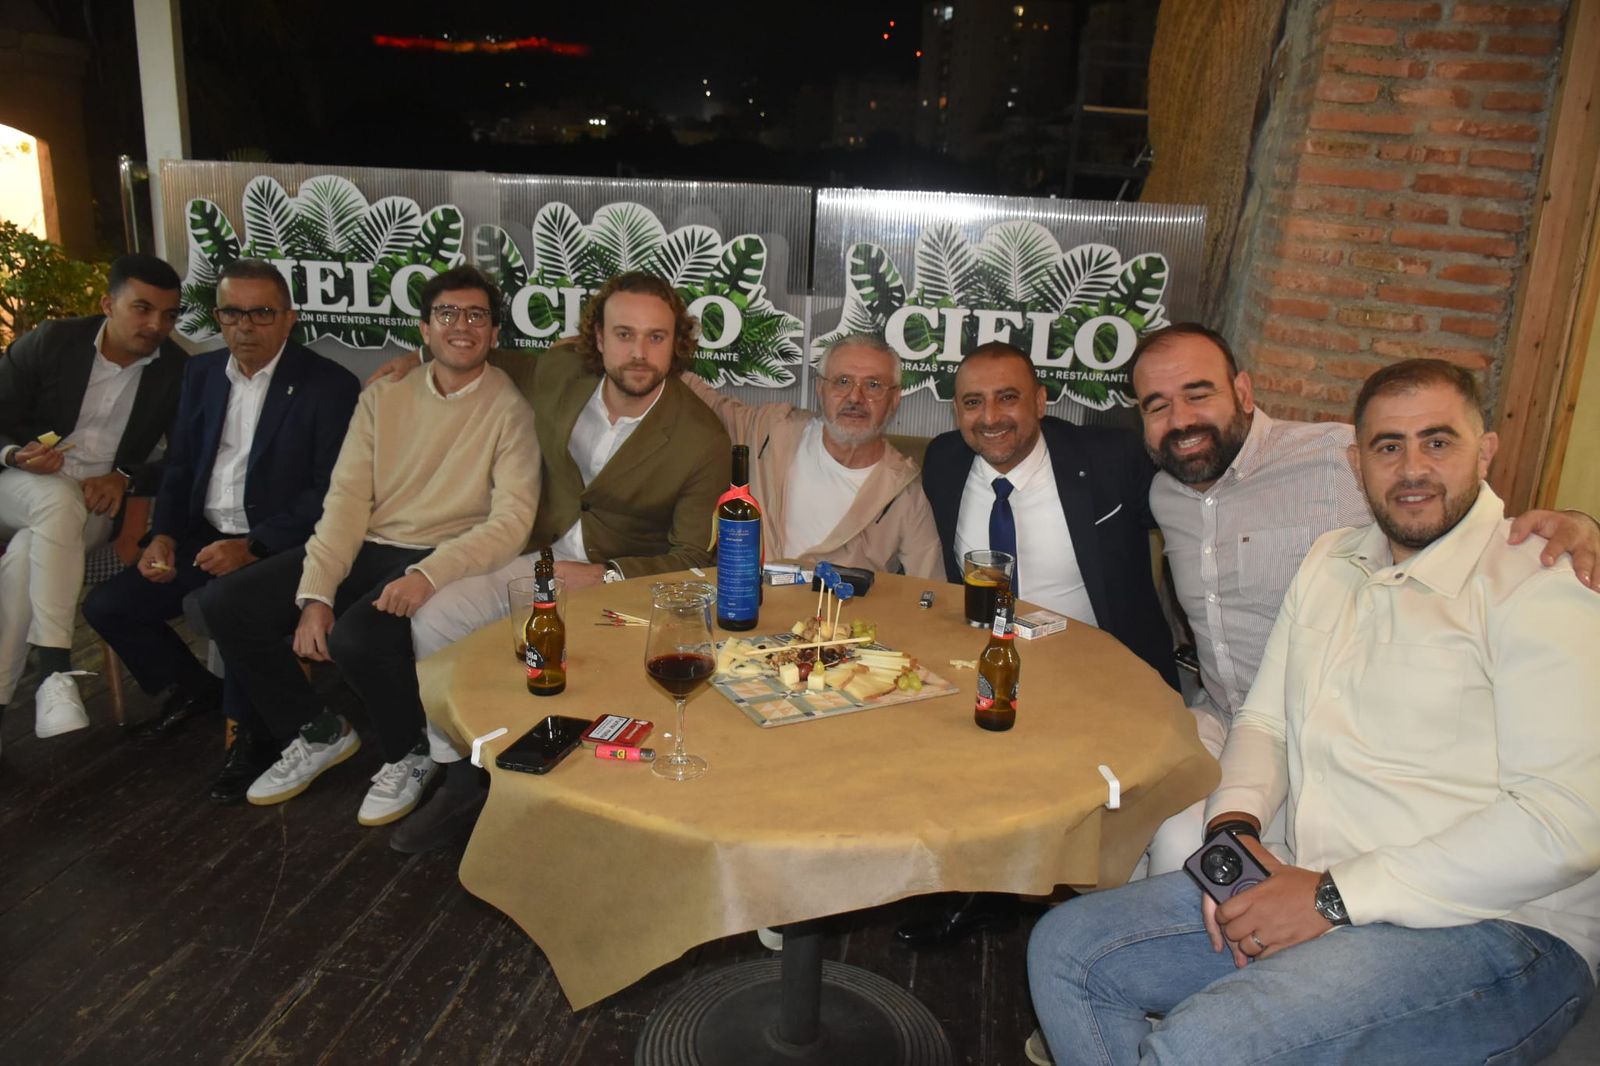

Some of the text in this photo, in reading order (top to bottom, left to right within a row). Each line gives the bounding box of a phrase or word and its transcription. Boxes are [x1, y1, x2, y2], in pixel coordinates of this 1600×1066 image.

[264, 257, 437, 317] IELO
[316, 314, 328, 323] DE
[330, 315, 371, 325] EVENTOS
[378, 317, 420, 327] RESTAUR
[511, 285, 742, 349] CIO
[885, 305, 1137, 371] CIELO
[514, 338, 739, 362] TERRAZ AURANTE
[901, 362, 938, 372] RRAZAS
